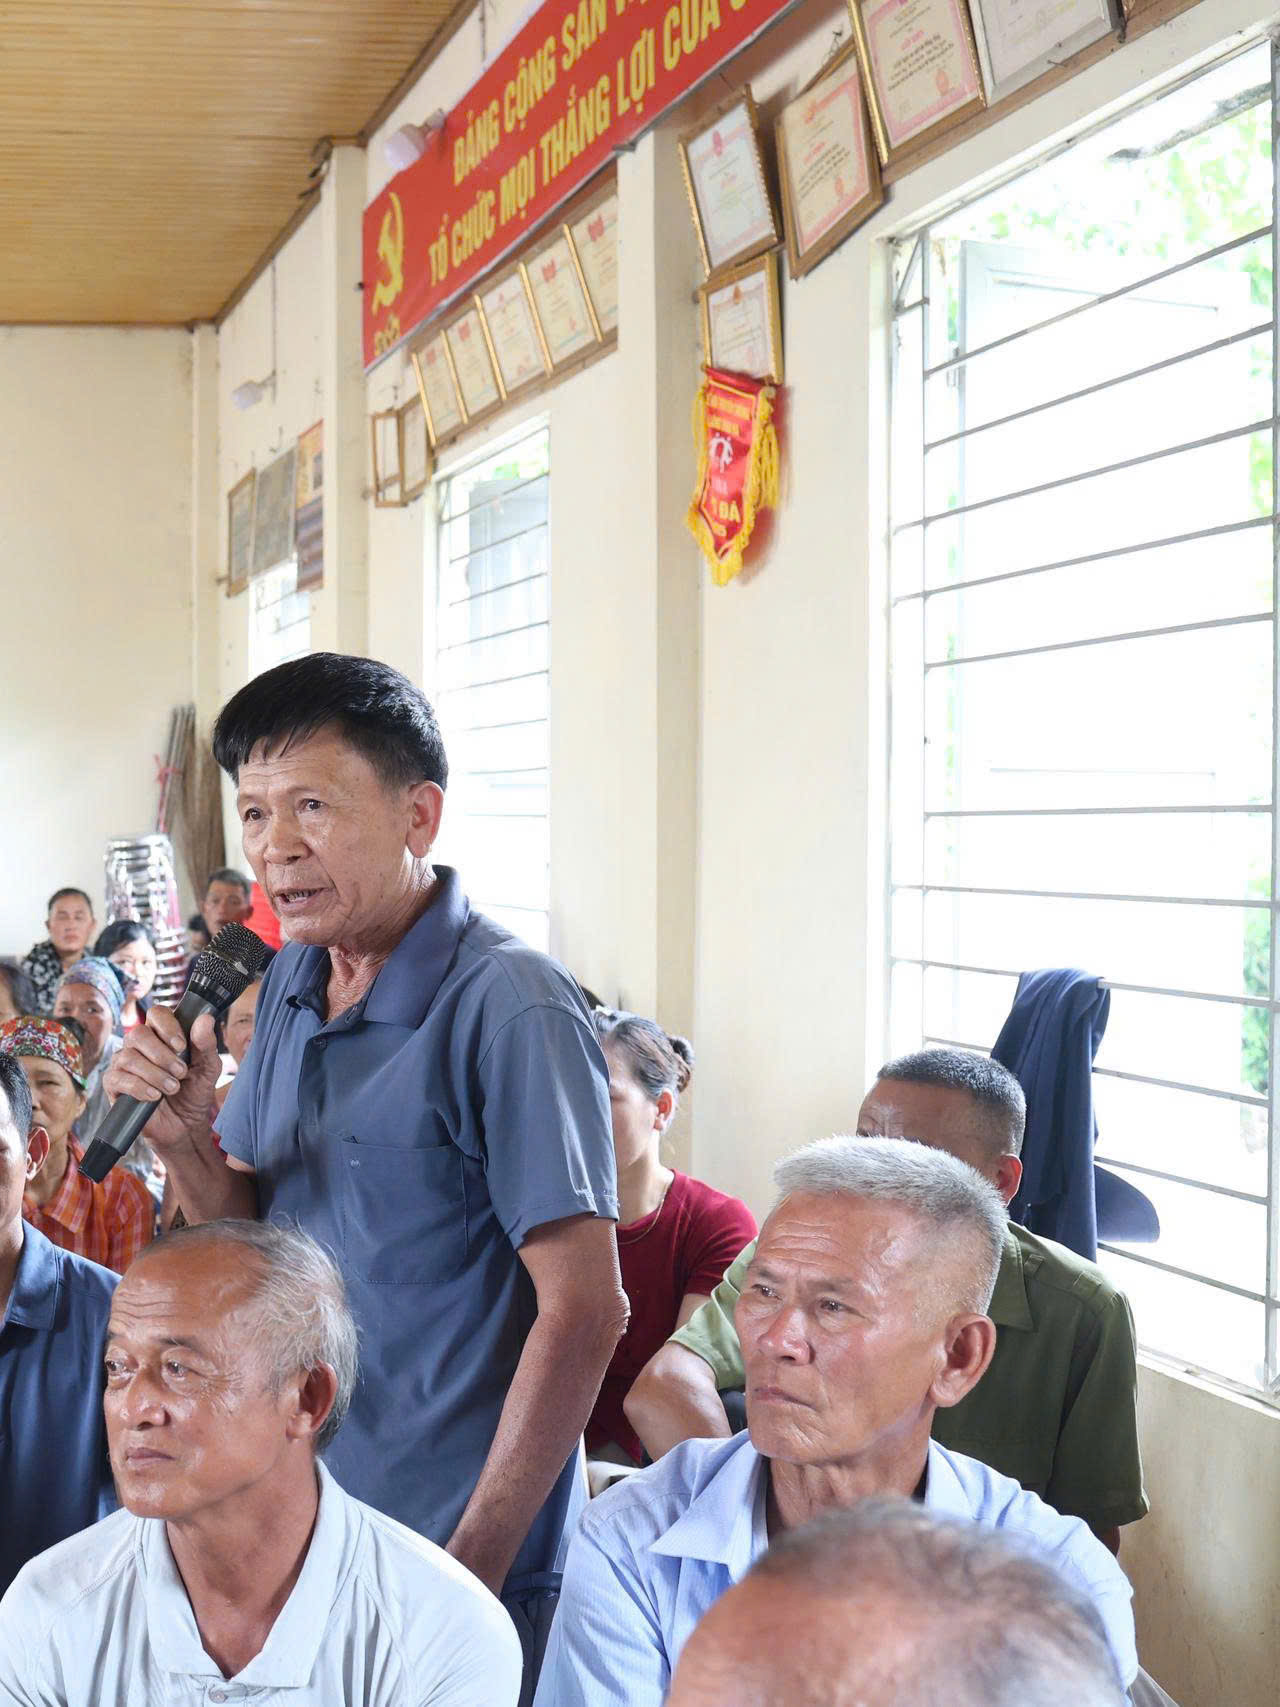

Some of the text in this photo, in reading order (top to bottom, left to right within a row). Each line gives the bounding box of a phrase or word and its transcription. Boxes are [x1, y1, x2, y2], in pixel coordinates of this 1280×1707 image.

[428, 213, 449, 287] TỔ
[451, 189, 496, 268] CHỨC
[499, 147, 536, 226] MỌI
[539, 74, 610, 186] THẮNG
[616, 28, 655, 116] LỢI
[503, 35, 556, 133] CỘNG
